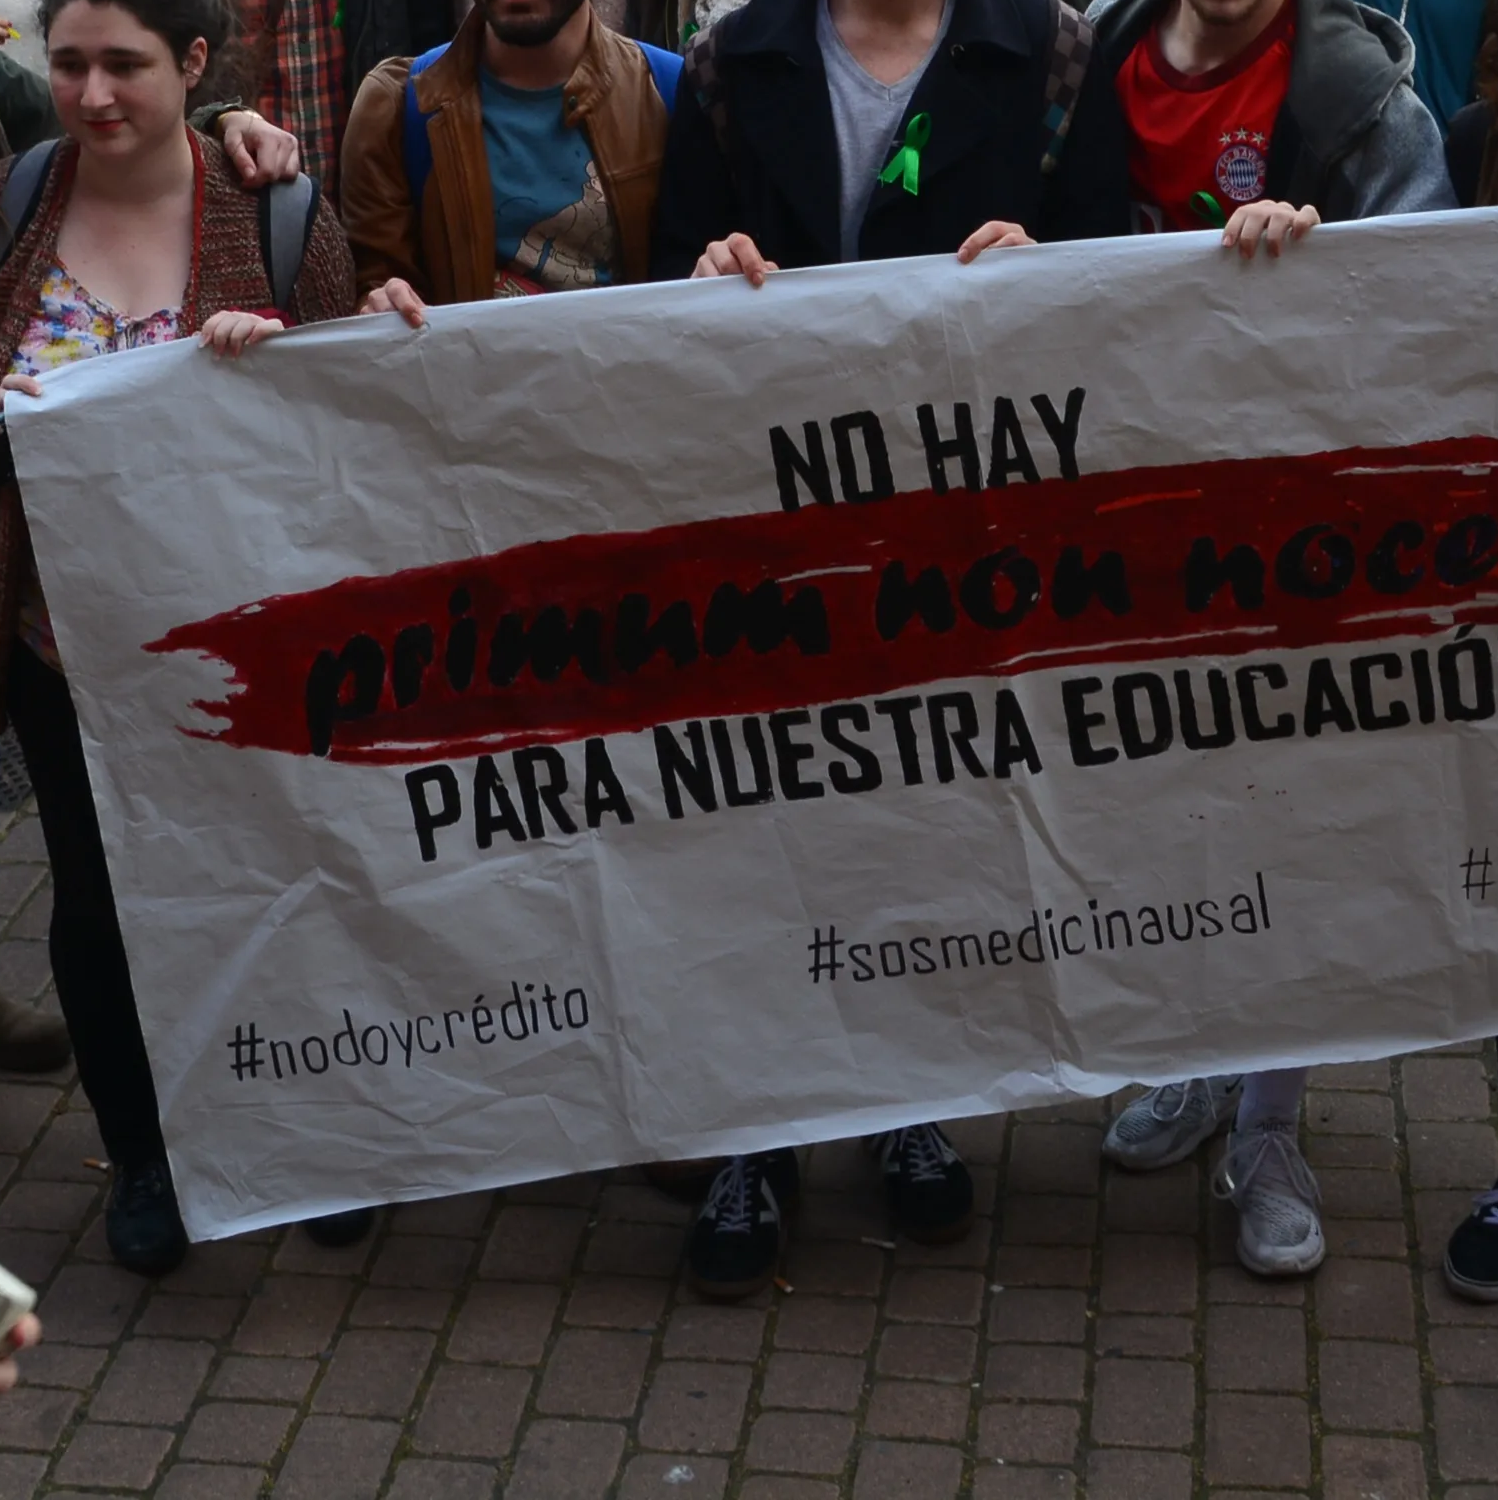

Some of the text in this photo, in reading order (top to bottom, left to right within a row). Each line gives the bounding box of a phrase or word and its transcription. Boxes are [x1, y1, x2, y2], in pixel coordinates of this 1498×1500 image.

[769, 386, 1086, 512] NO HAY
[404, 738, 635, 862] PARA
[655, 688, 1043, 821] NUESTRA
[807, 872, 1272, 984] #sosmedicinausal
[227, 982, 591, 1082] #nodoycrédito
